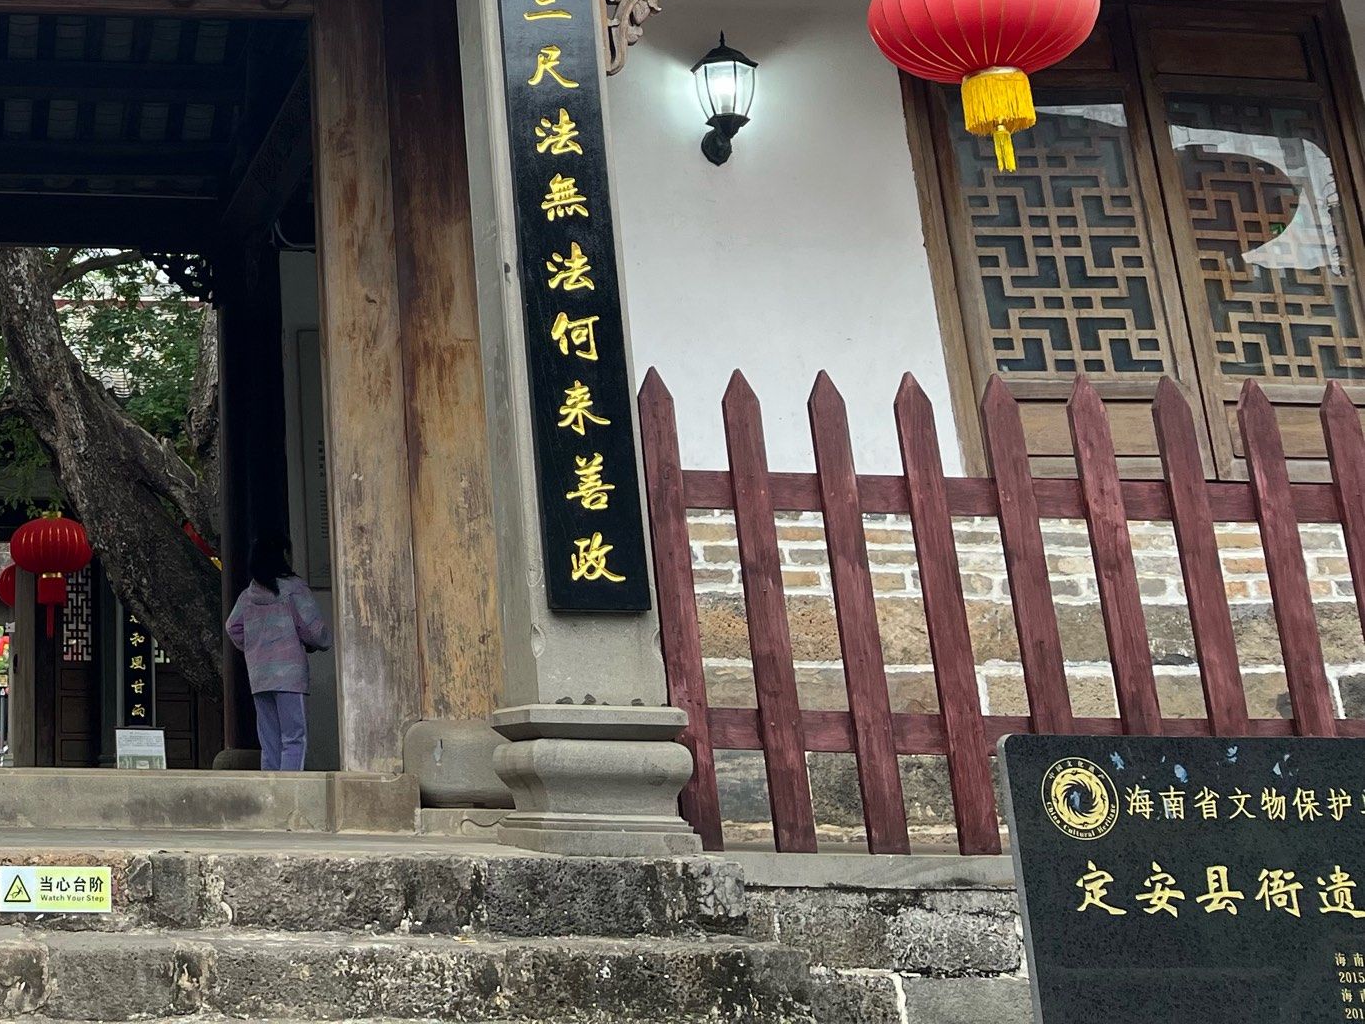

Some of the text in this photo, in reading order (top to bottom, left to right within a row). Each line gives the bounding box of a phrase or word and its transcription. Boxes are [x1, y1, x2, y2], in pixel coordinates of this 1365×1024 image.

[1124, 784, 1365, 822] 海南省文物保护
[1063, 824, 1096, 838] Cultural
[40, 875, 104, 893] 当心台阶
[1076, 860, 1365, 919] 定安县衙遗
[40, 894, 105, 903] Watch Your Step
